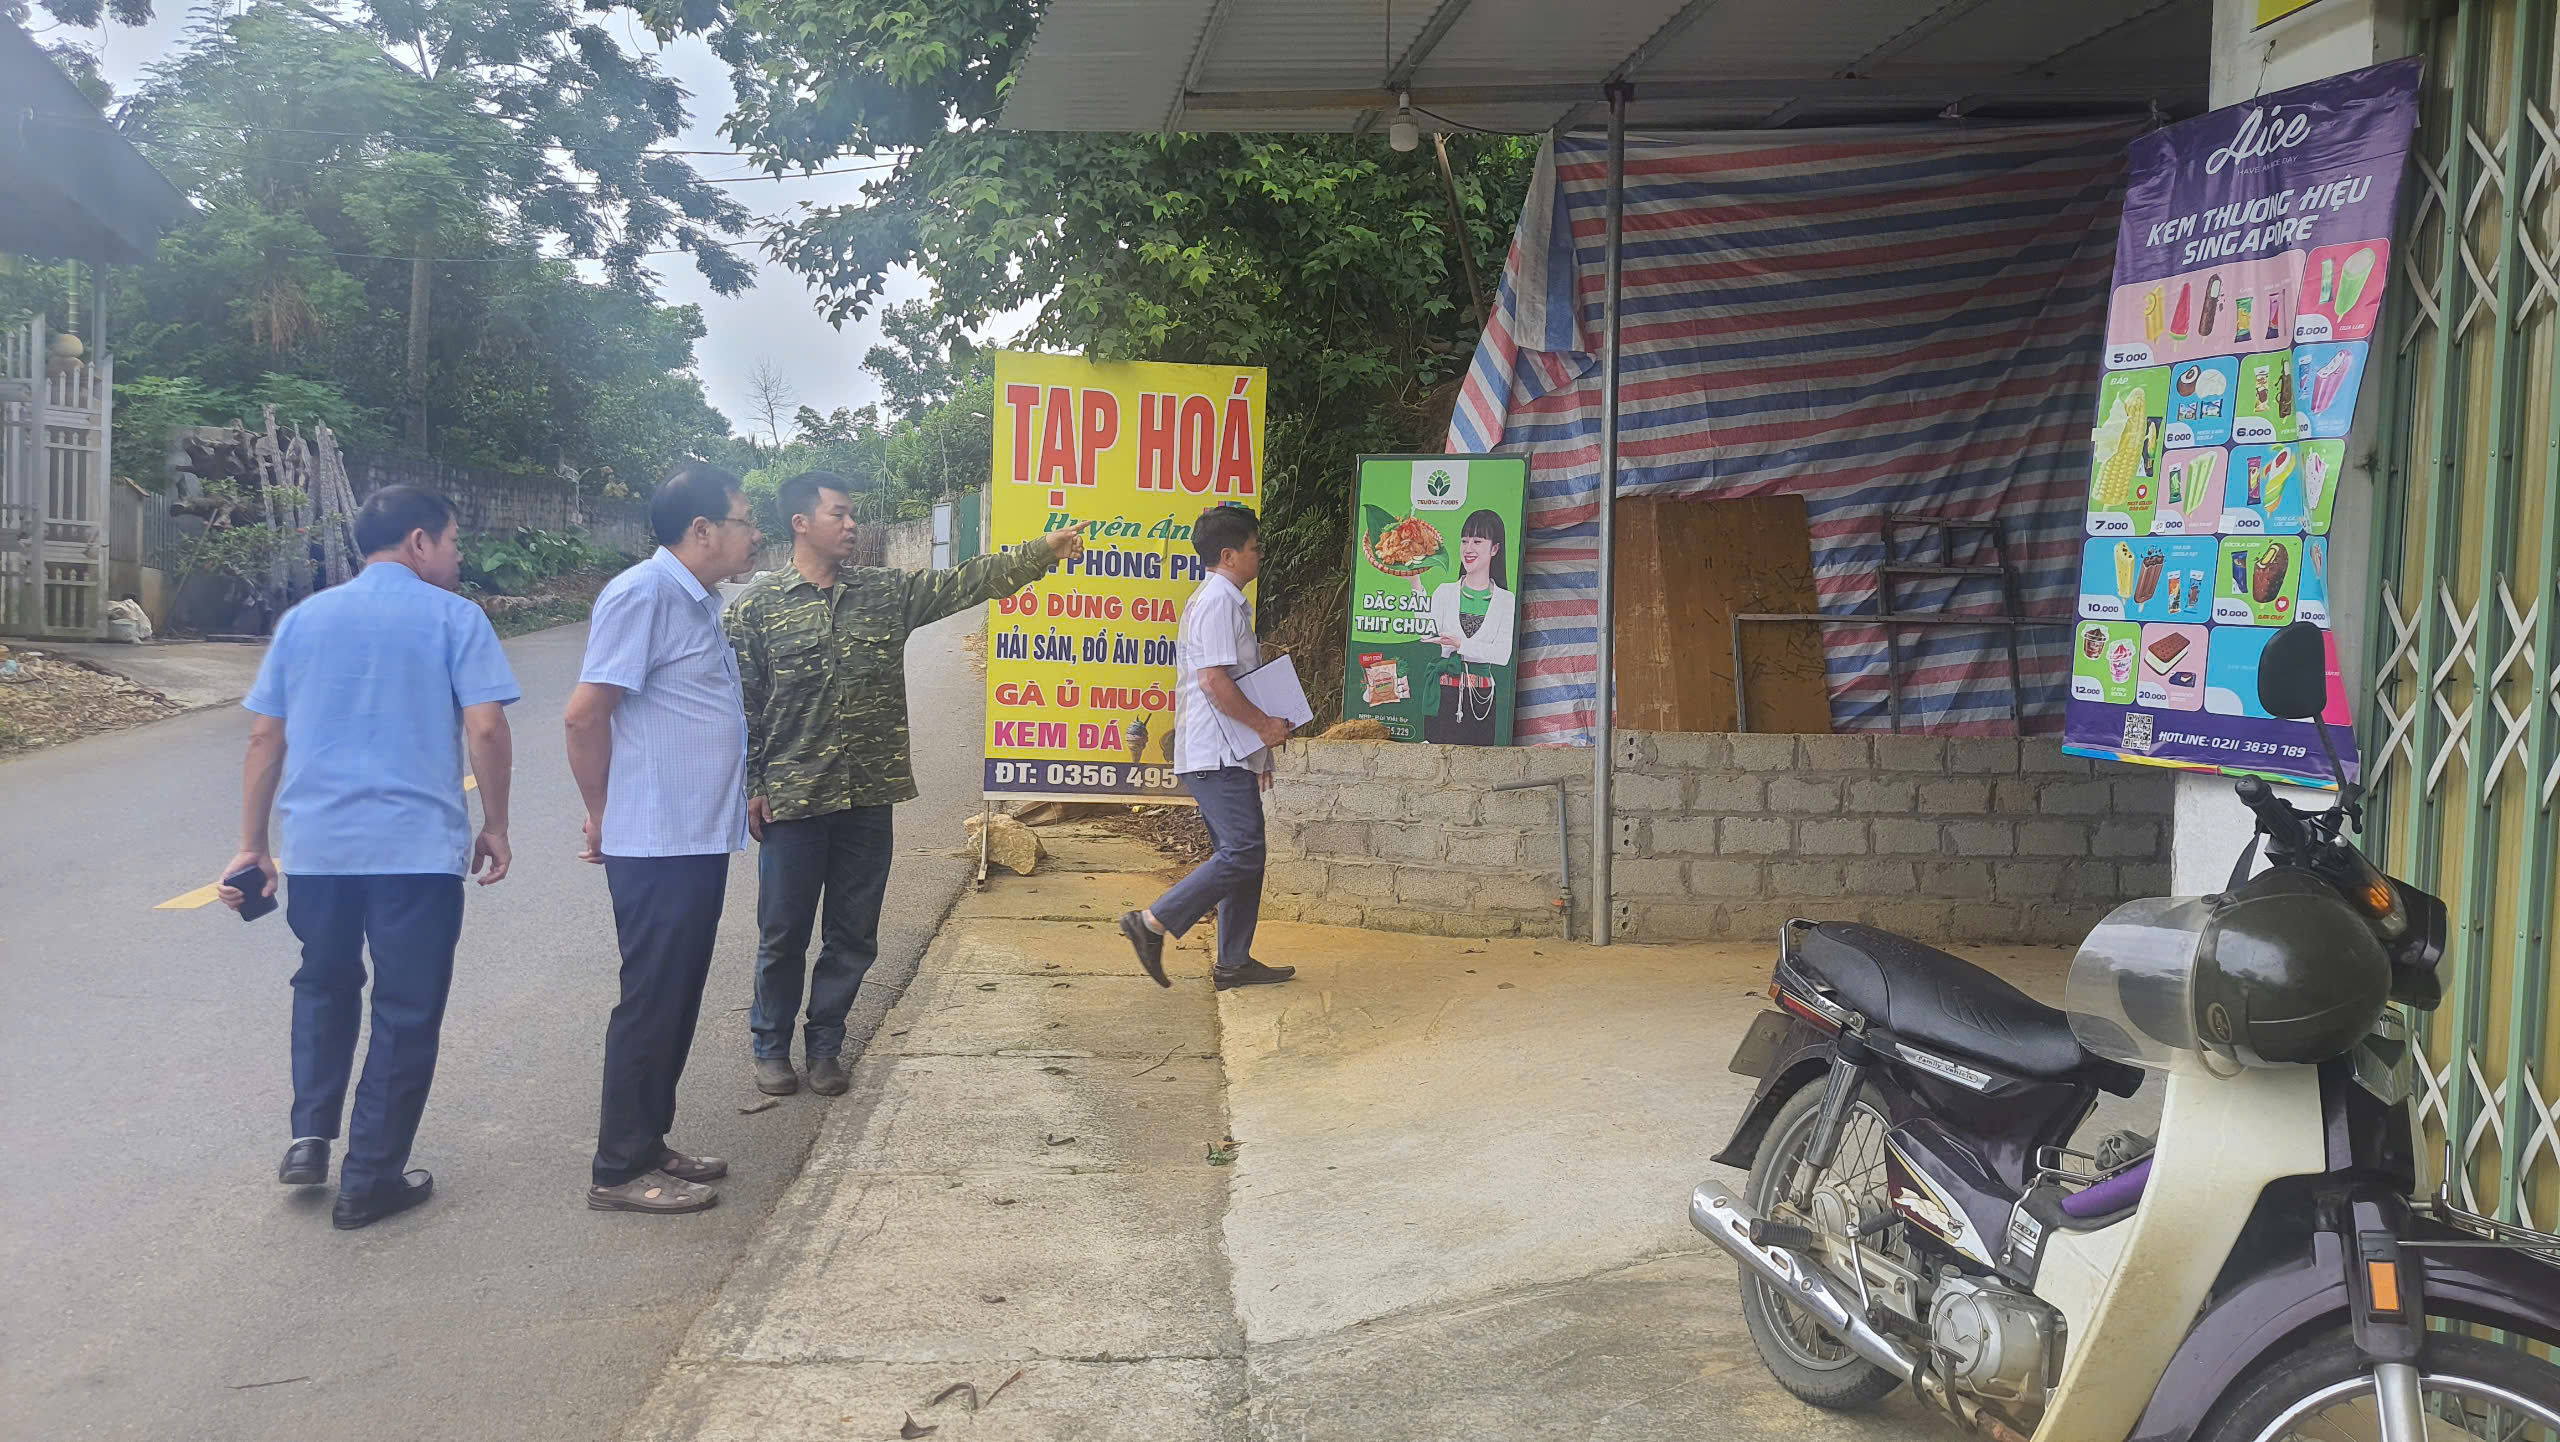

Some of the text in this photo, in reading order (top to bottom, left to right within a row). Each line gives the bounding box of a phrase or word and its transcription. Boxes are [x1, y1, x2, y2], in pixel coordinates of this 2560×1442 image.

[2205, 104, 2312, 175] Aice
[2146, 213, 2197, 247] KEM
[2299, 174, 2373, 211] HIỆU
[2182, 214, 2320, 266] SINGAPORE
[2296, 326, 2328, 337] 6.000
[2114, 352, 2147, 363] 5.000
[1005, 375, 1257, 508] TẠP HOÁ
[2237, 427, 2271, 437] 6.000
[1147, 512, 1195, 541] Án
[2095, 520, 2129, 530] 7.000
[1067, 544, 1161, 581] PHÒNG
[1170, 554, 1206, 581] PH
[998, 585, 1178, 623] ĐỒ DÙNG GIA
[1398, 591, 1432, 613] SẢN
[2088, 603, 2119, 613] 10.000
[2216, 608, 2248, 617] 10.000
[1392, 618, 1439, 636] CHUA
[2301, 611, 2325, 620] 10.000
[996, 625, 1178, 666] HẢI SẢN, ĐỒ ĂN ĐÔN
[994, 680, 1047, 707] GÀ
[1056, 679, 1081, 708] Ủ
[2075, 685, 2100, 695] 12.000
[2138, 691, 2167, 701] 20.000
[994, 719, 1123, 750] KEM ĐÁ
[2158, 730, 2307, 758] HOTLINE: 0211 3839 789
[995, 762, 1178, 789] ĐT: 0356 495
[2015, 1222, 2038, 1240] CDI
